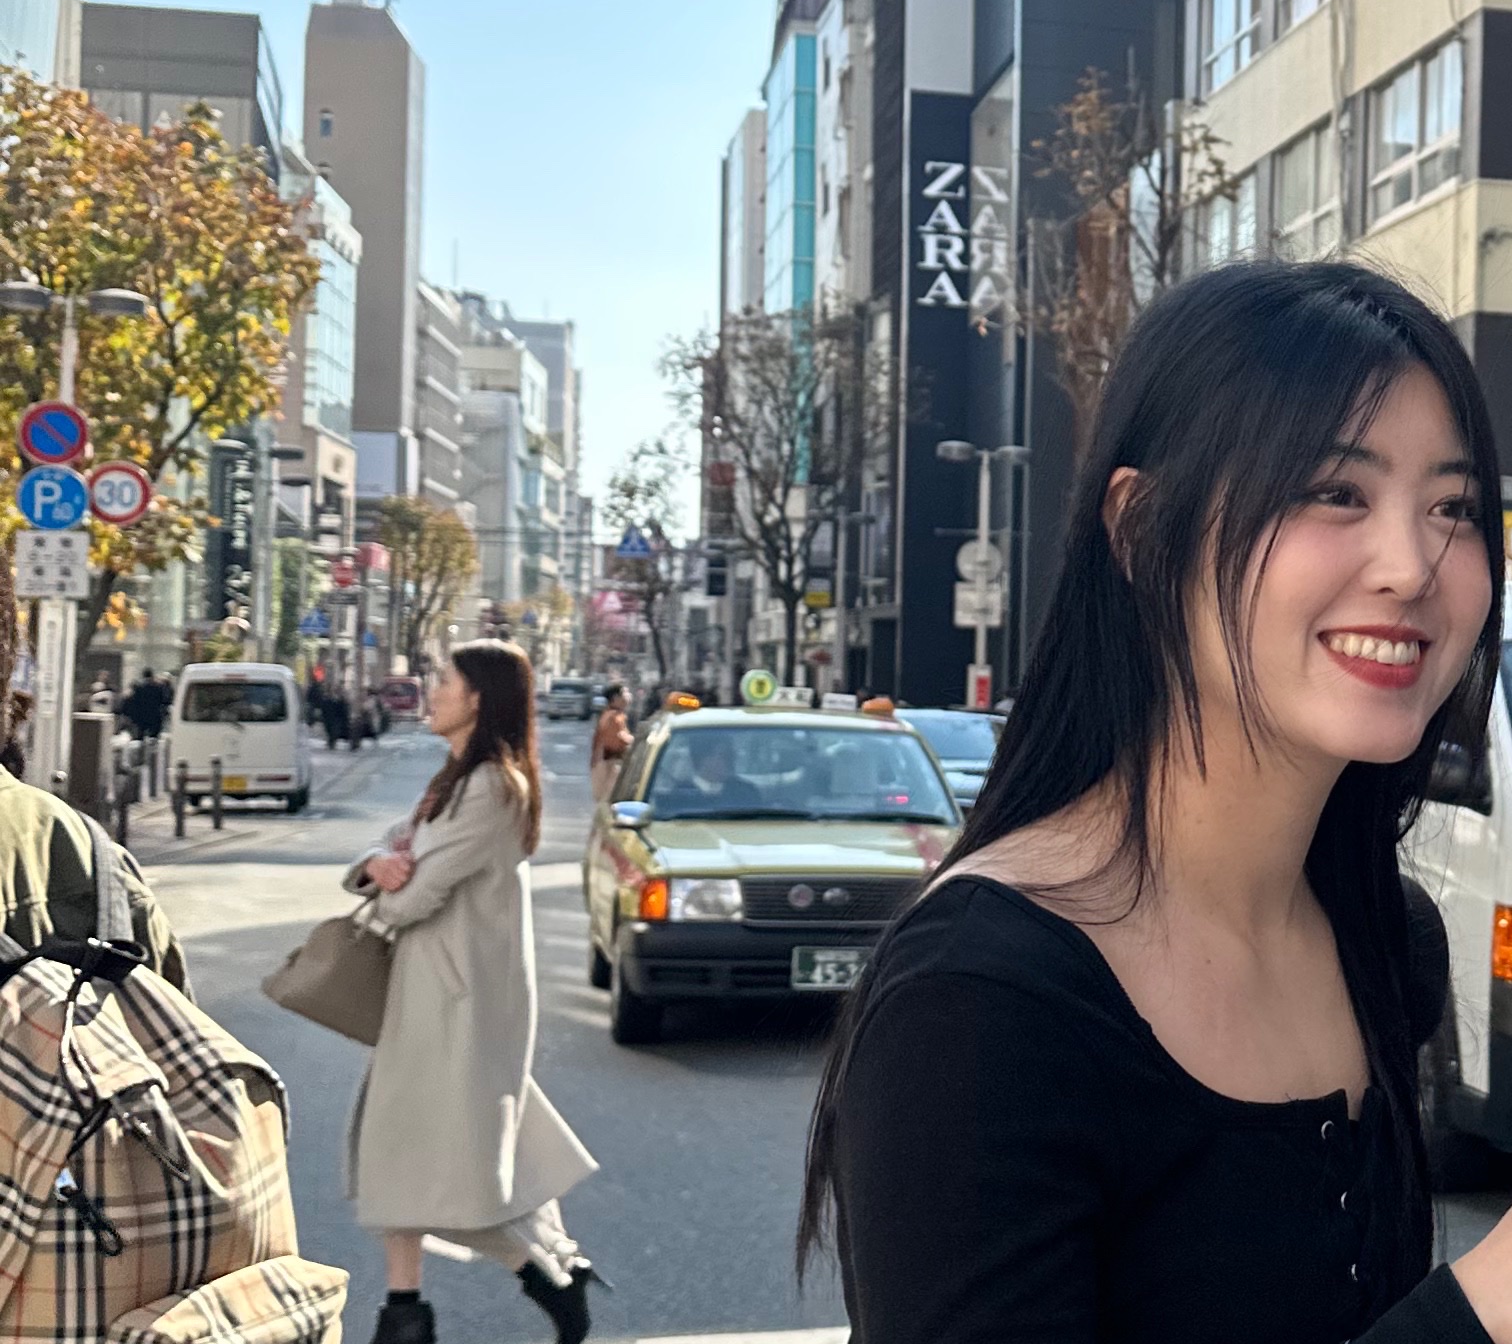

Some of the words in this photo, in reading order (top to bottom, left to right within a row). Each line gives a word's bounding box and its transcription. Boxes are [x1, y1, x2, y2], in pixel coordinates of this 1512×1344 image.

[916, 159, 968, 307] ZARA
[33, 479, 63, 521] P
[99, 479, 138, 508] 30
